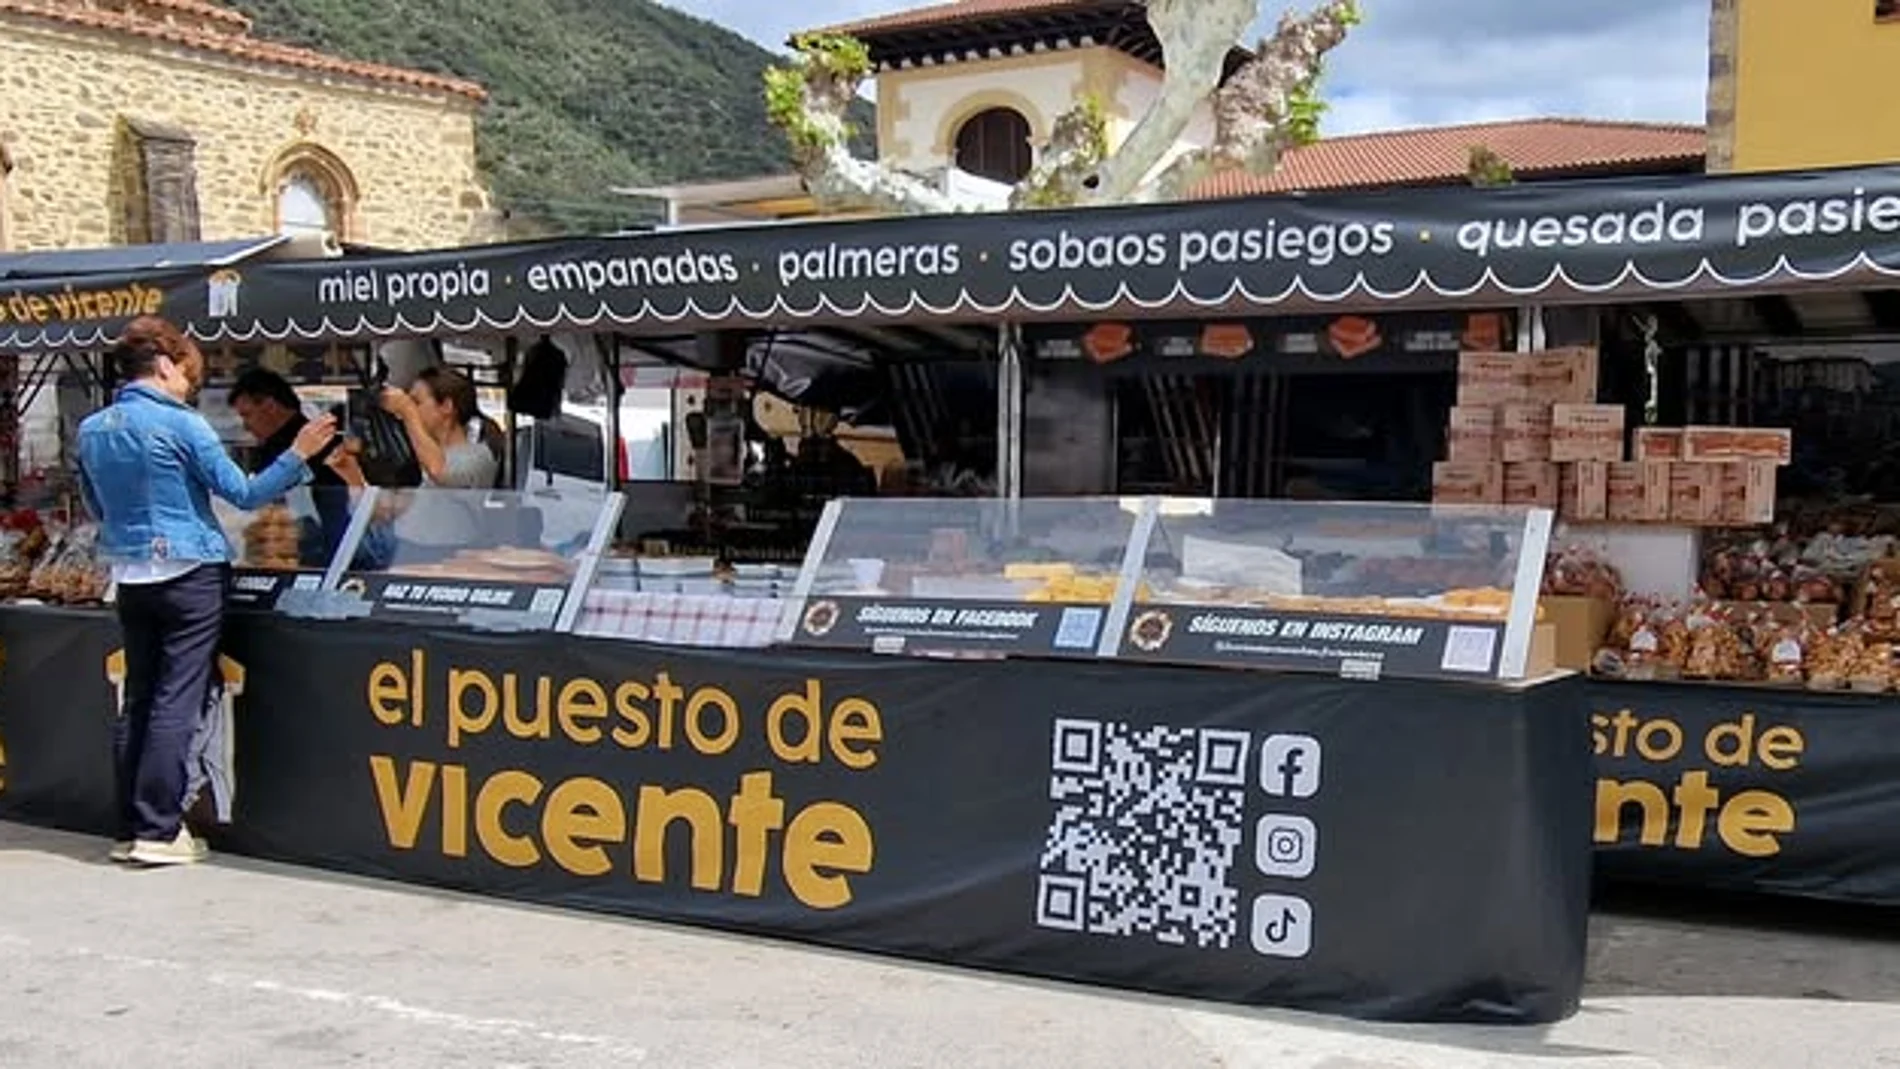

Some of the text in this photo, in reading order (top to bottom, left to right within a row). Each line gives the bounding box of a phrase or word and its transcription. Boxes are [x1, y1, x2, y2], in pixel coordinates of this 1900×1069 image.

[318, 269, 378, 303] miel
[387, 267, 490, 305] propia
[526, 248, 740, 293] empanadas
[778, 241, 961, 286] palmeras
[1008, 229, 1167, 271] sobaos
[1179, 217, 1396, 270] pasiegos
[1456, 200, 1705, 257] quesada
[8, 282, 164, 324] de vicente
[932, 608, 955, 625] EN
[956, 609, 1039, 629] FACEBOOK
[1281, 621, 1305, 638] EN
[1310, 621, 1425, 645] INSTAGRAM
[368, 648, 883, 769] el puesto de
[1704, 712, 1805, 770] de
